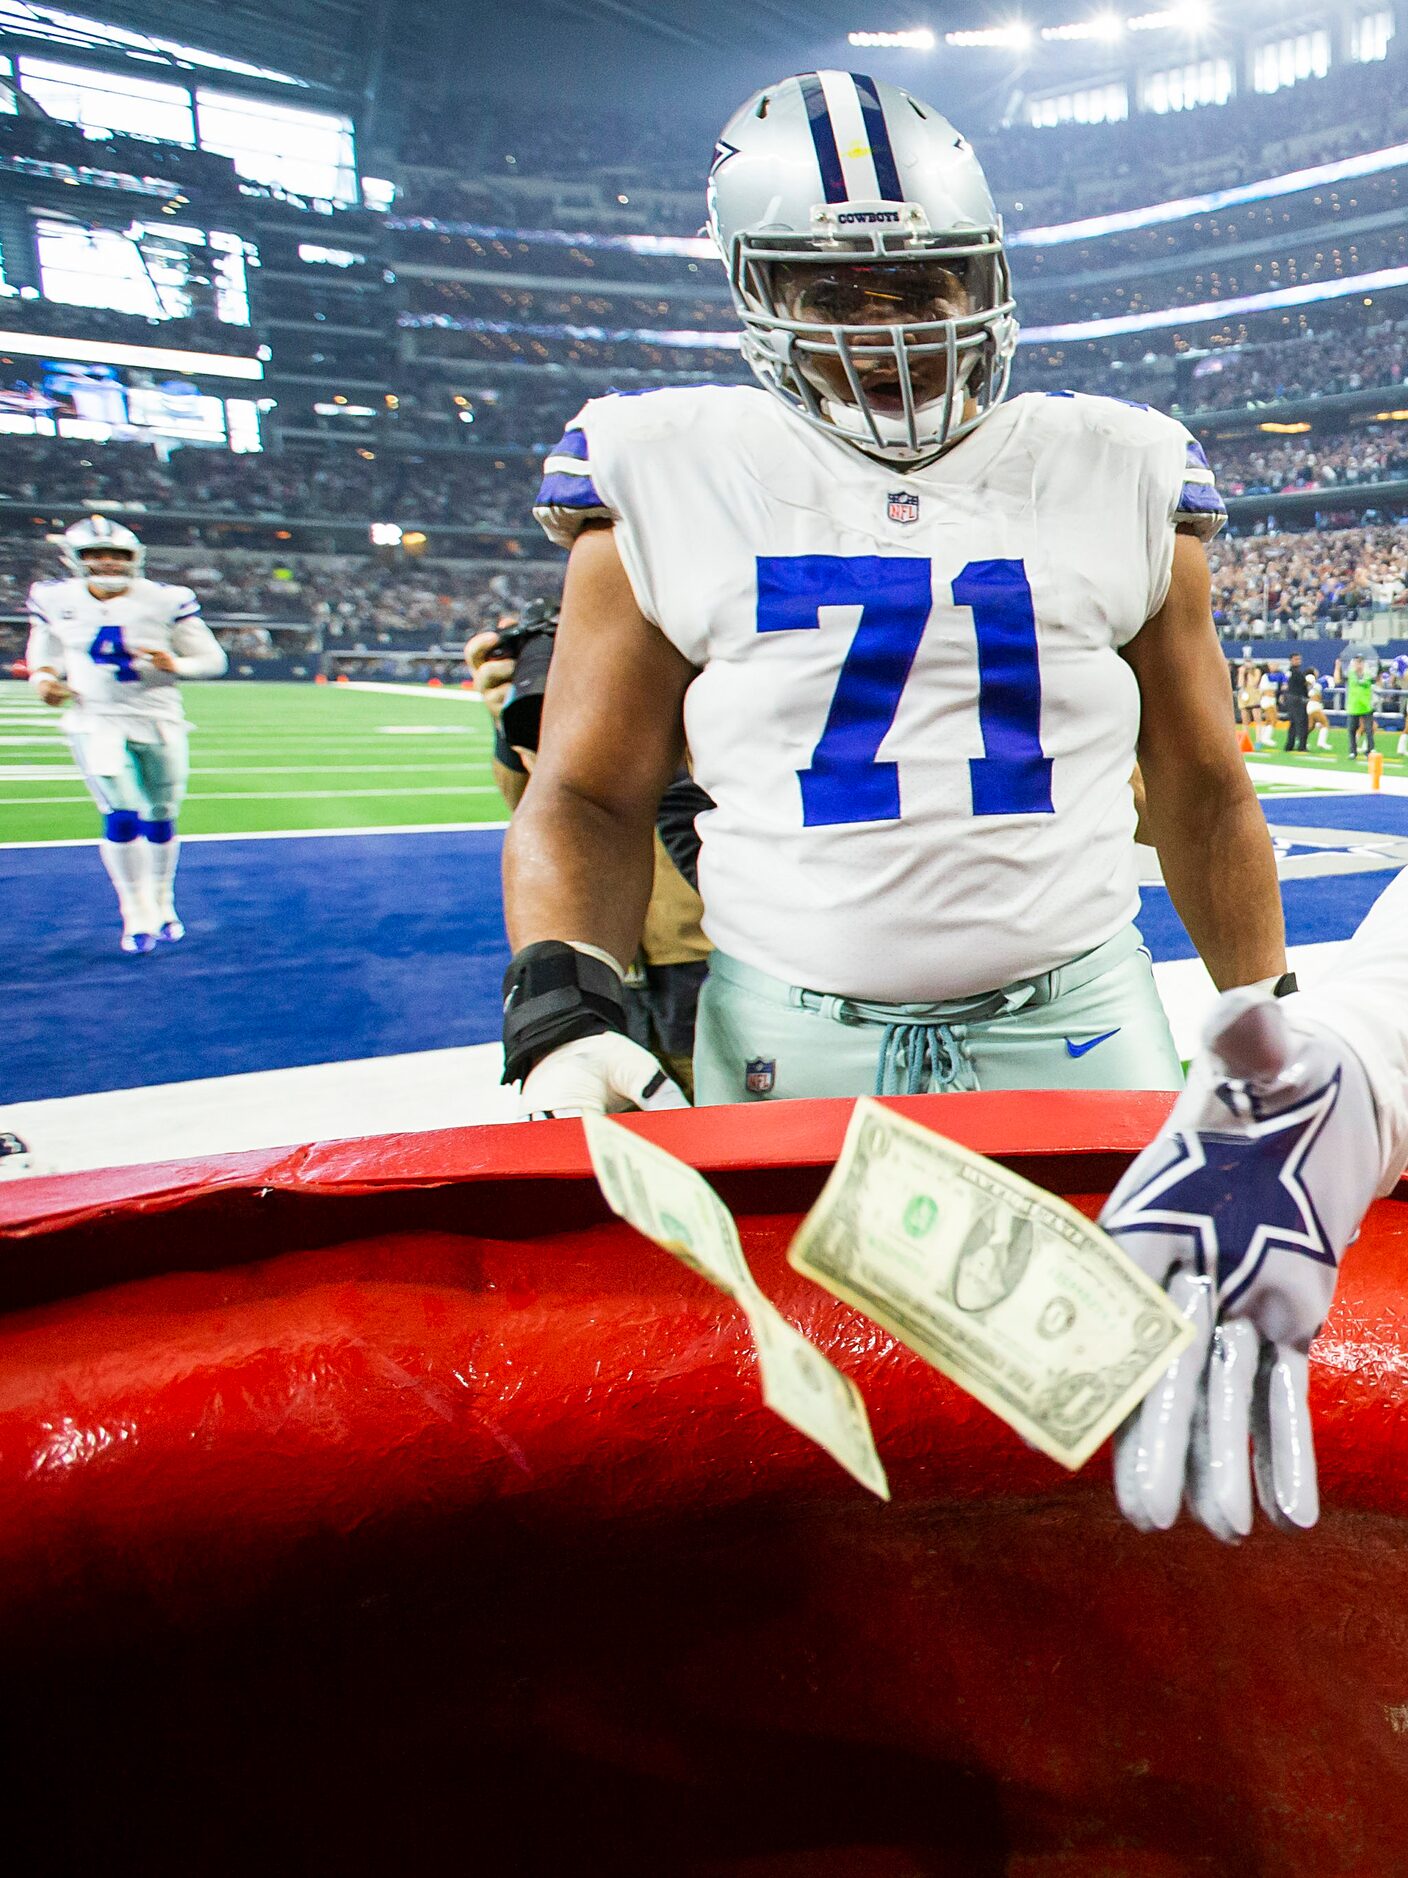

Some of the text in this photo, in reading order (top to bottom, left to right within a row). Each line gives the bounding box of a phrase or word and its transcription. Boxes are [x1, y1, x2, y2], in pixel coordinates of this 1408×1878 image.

[838, 211, 900, 224] COWBOYS
[889, 504, 916, 521] NFL
[87, 625, 143, 682] 4
[755, 554, 1055, 827] 71
